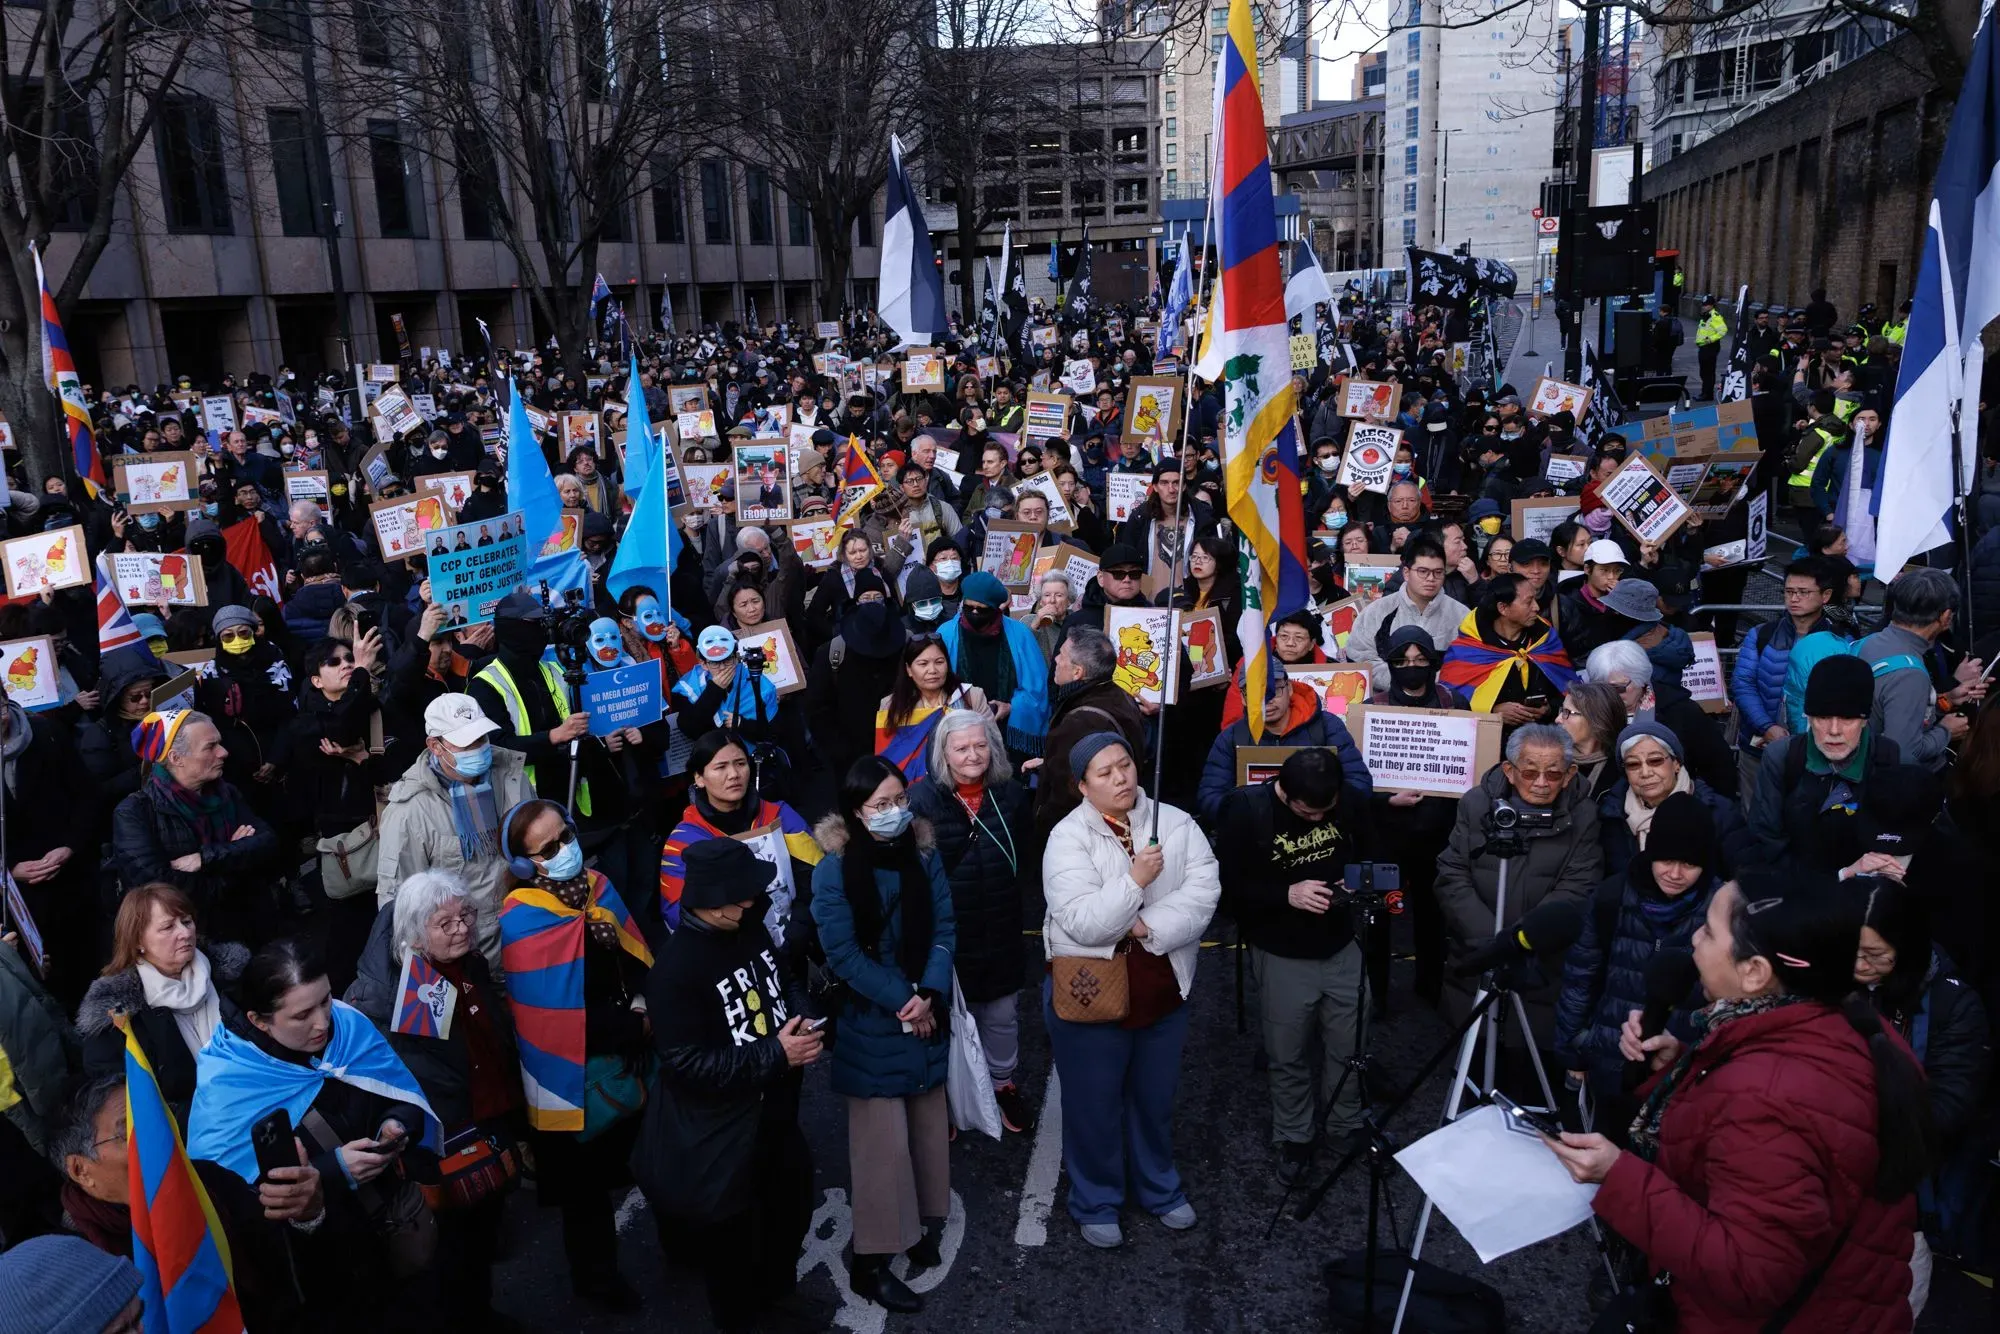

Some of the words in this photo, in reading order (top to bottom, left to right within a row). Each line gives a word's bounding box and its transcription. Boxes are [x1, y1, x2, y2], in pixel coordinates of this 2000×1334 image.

[1293, 344, 1312, 352] NA'S
[1292, 360, 1315, 369] ASSY
[1355, 429, 1395, 442] MEGA
[1353, 437, 1394, 449] EMBASSY
[1347, 462, 1389, 476] WATCHING
[1033, 475, 1049, 486] China
[1351, 472, 1384, 486] YOU
[1629, 501, 1640, 512] THEY
[1641, 499, 1659, 517] YOU
[1654, 487, 1671, 504] PAY
[376, 510, 396, 519] Labour
[377, 516, 397, 524] loving
[743, 508, 768, 520] FROM
[770, 508, 788, 519] CCP
[1650, 510, 1662, 522] SUPER
[1642, 526, 1655, 538] Don't
[1651, 519, 1661, 529] sell
[1658, 513, 1668, 523] out
[440, 559, 462, 573] CCP
[1067, 564, 1087, 576] loving
[1069, 558, 1091, 570] Labour
[455, 571, 475, 585] BUT
[479, 559, 517, 580] GENOCIDE
[1076, 573, 1085, 581] UK
[446, 582, 494, 602] DEMANDS
[496, 570, 524, 590] JUSTICE
[1688, 678, 1700, 687] still
[1700, 677, 1717, 687] lying.
[591, 693, 601, 703] NO
[602, 690, 621, 701] MEGA
[622, 682, 650, 696] EMBASSY
[597, 705, 607, 715] NO
[607, 699, 637, 712] REWARDS
[637, 694, 649, 705] FOR
[610, 707, 639, 723] GENOCIDE
[1397, 719, 1410, 728] they
[1422, 721, 1439, 729] lying.
[1371, 726, 1383, 734] They
[1401, 727, 1414, 735] they
[1426, 729, 1443, 737] lying.
[1370, 734, 1383, 743] They
[1428, 737, 1440, 745] they
[1453, 739, 1470, 747] lying.
[1419, 744, 1435, 752] know
[1369, 750, 1381, 758] they
[1426, 753, 1439, 762] they
[1451, 755, 1468, 763] lying.
[1368, 759, 1384, 769] But
[1385, 759, 1405, 773] they
[1406, 762, 1422, 771] are
[1423, 762, 1441, 773] still
[1442, 763, 1467, 776] lying.
[1418, 776, 1436, 784] mega
[1437, 777, 1467, 786] embassy
